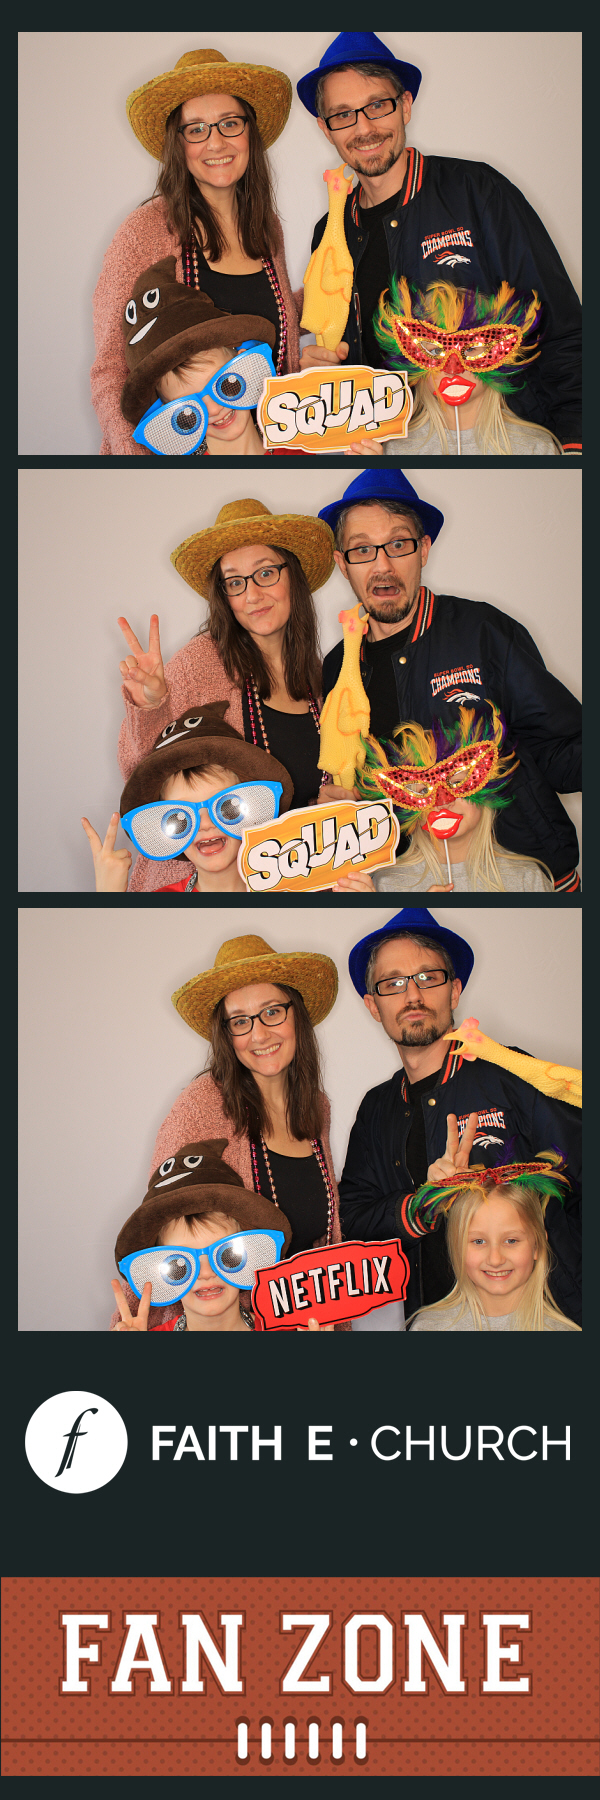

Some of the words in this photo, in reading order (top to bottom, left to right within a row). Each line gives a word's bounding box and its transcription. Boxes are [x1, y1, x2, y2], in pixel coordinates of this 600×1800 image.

[421, 230, 474, 260] CHAMPIONS
[265, 373, 406, 444] SQUAD
[430, 667, 483, 697] CHAMPIONS
[433, 670, 450, 678] SUPER
[247, 803, 392, 891] SQUAD
[268, 1256, 393, 1318] NETFLIX
